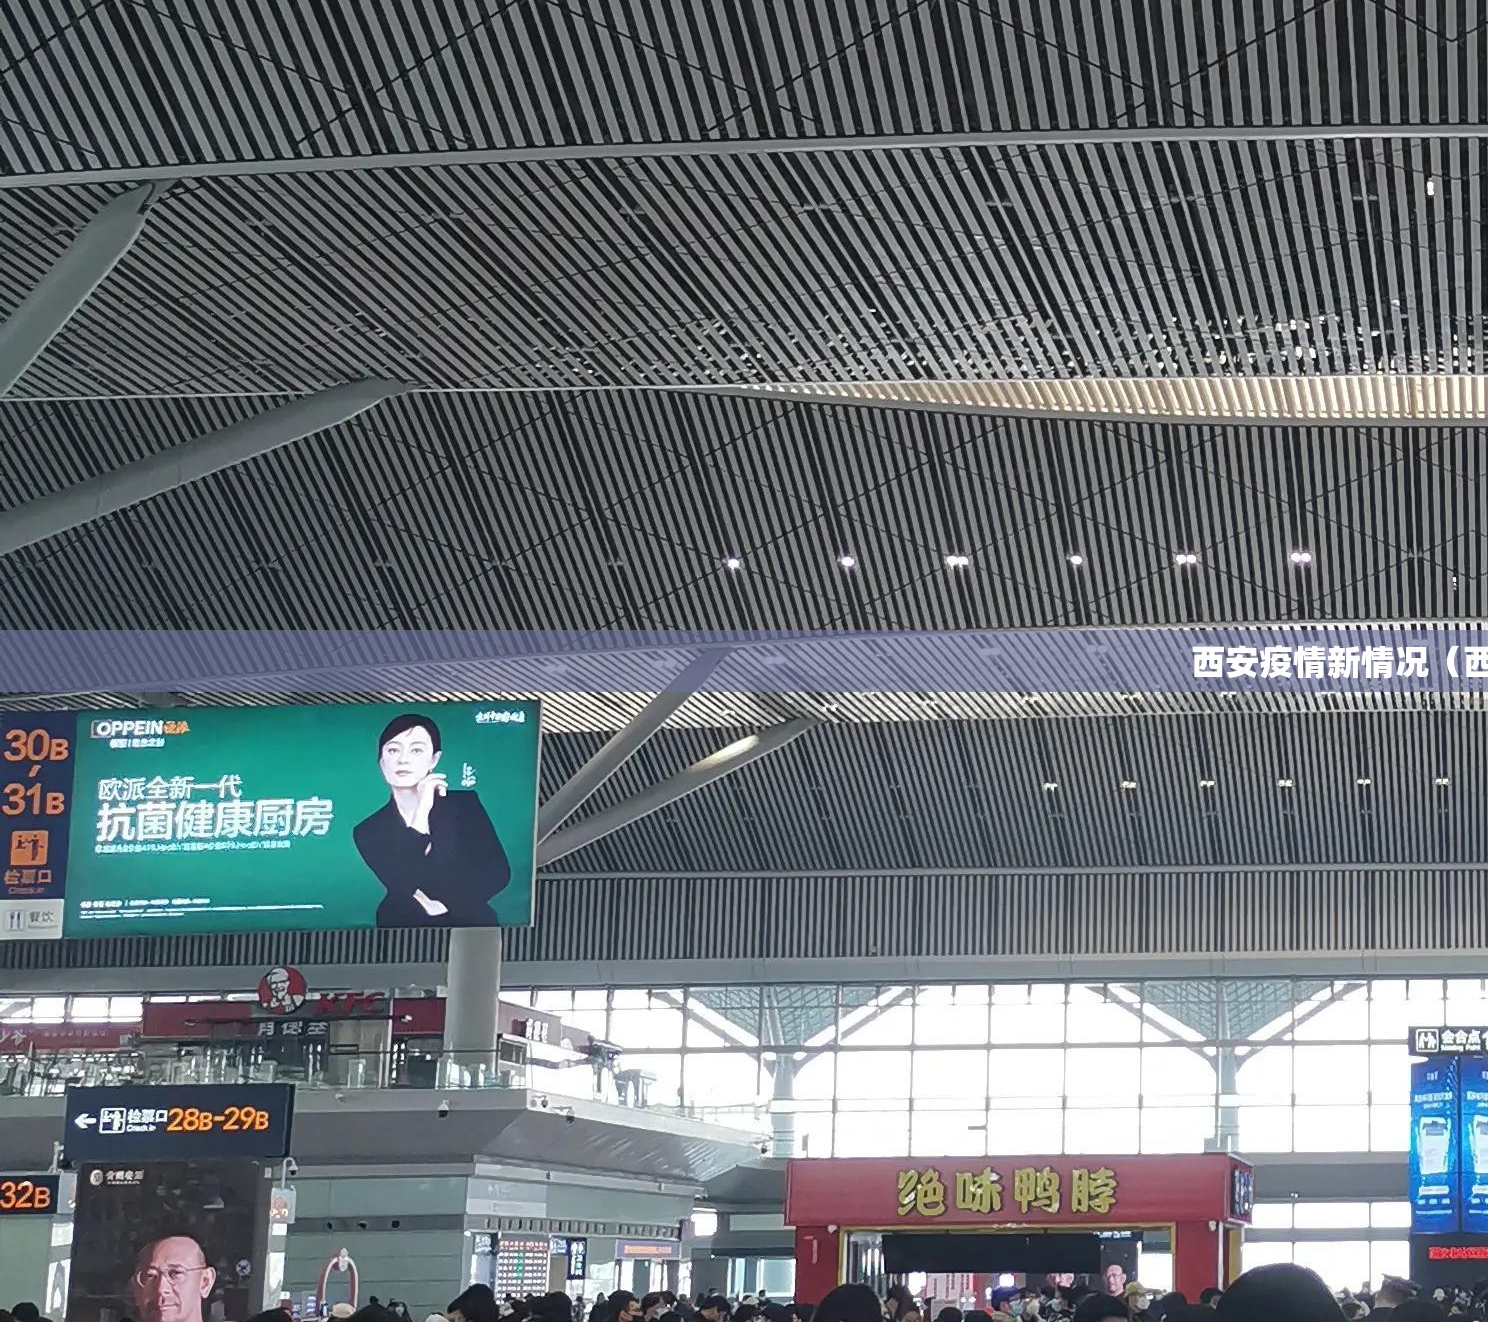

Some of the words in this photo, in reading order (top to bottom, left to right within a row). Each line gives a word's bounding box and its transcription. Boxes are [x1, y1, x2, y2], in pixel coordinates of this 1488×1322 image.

[96, 720, 164, 737] OPPEIN
[4, 728, 69, 762] 30B
[2, 783, 65, 816] 31B
[98, 774, 244, 801] 欧派全新一代
[96, 797, 335, 842] 抗菌健康厨房
[167, 1107, 269, 1132] 28B-29B
[0, 1181, 51, 1209] 32B
[897, 1166, 1117, 1217] 绝味鸭脖
